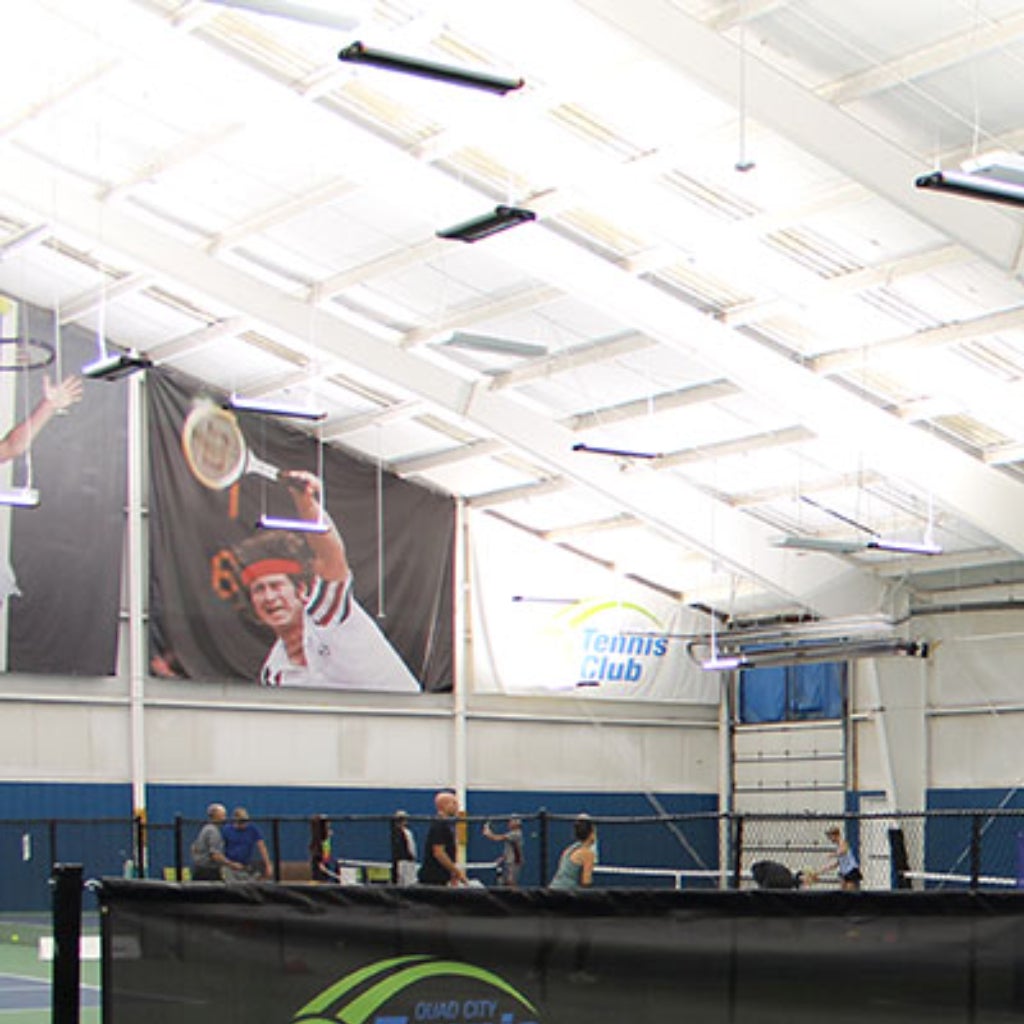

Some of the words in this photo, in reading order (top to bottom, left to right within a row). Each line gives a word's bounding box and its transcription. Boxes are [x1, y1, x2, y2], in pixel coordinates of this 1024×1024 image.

[583, 628, 668, 656] Tennis
[581, 655, 643, 681] Club
[414, 1001, 459, 1020] QUAD
[463, 999, 498, 1019] CITY
